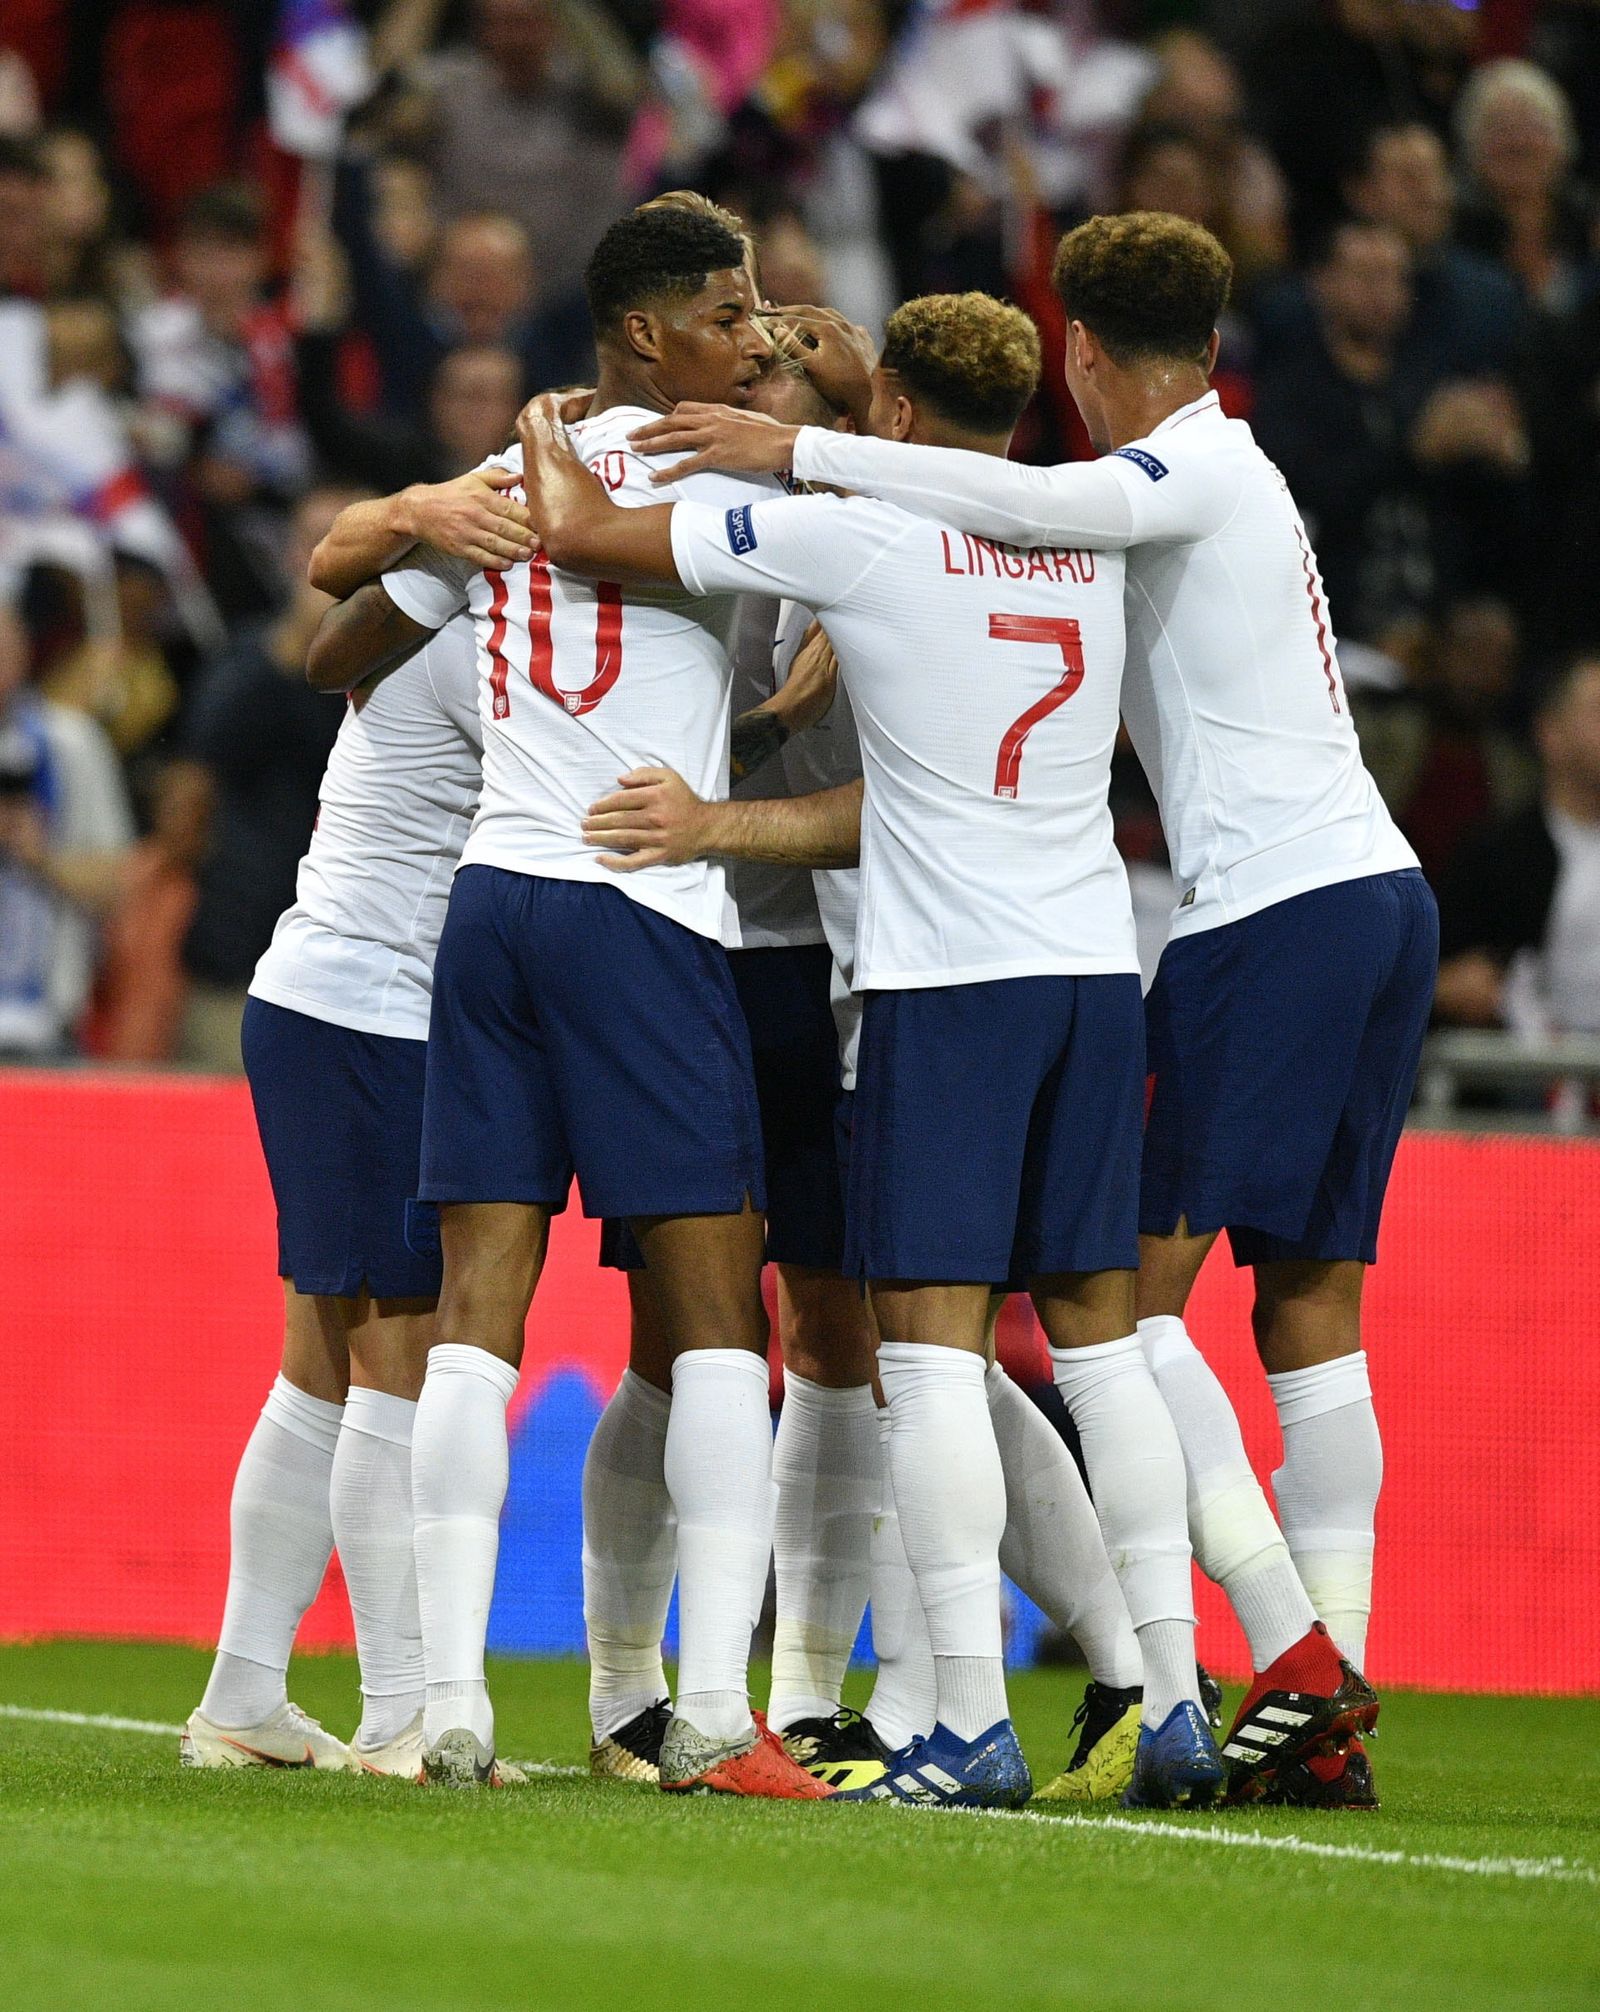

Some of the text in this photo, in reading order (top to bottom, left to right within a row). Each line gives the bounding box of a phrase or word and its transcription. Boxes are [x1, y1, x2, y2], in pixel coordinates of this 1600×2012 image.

[483, 545, 623, 720] 10
[940, 530, 1096, 584] LINGARD
[988, 612, 1085, 799] 7
